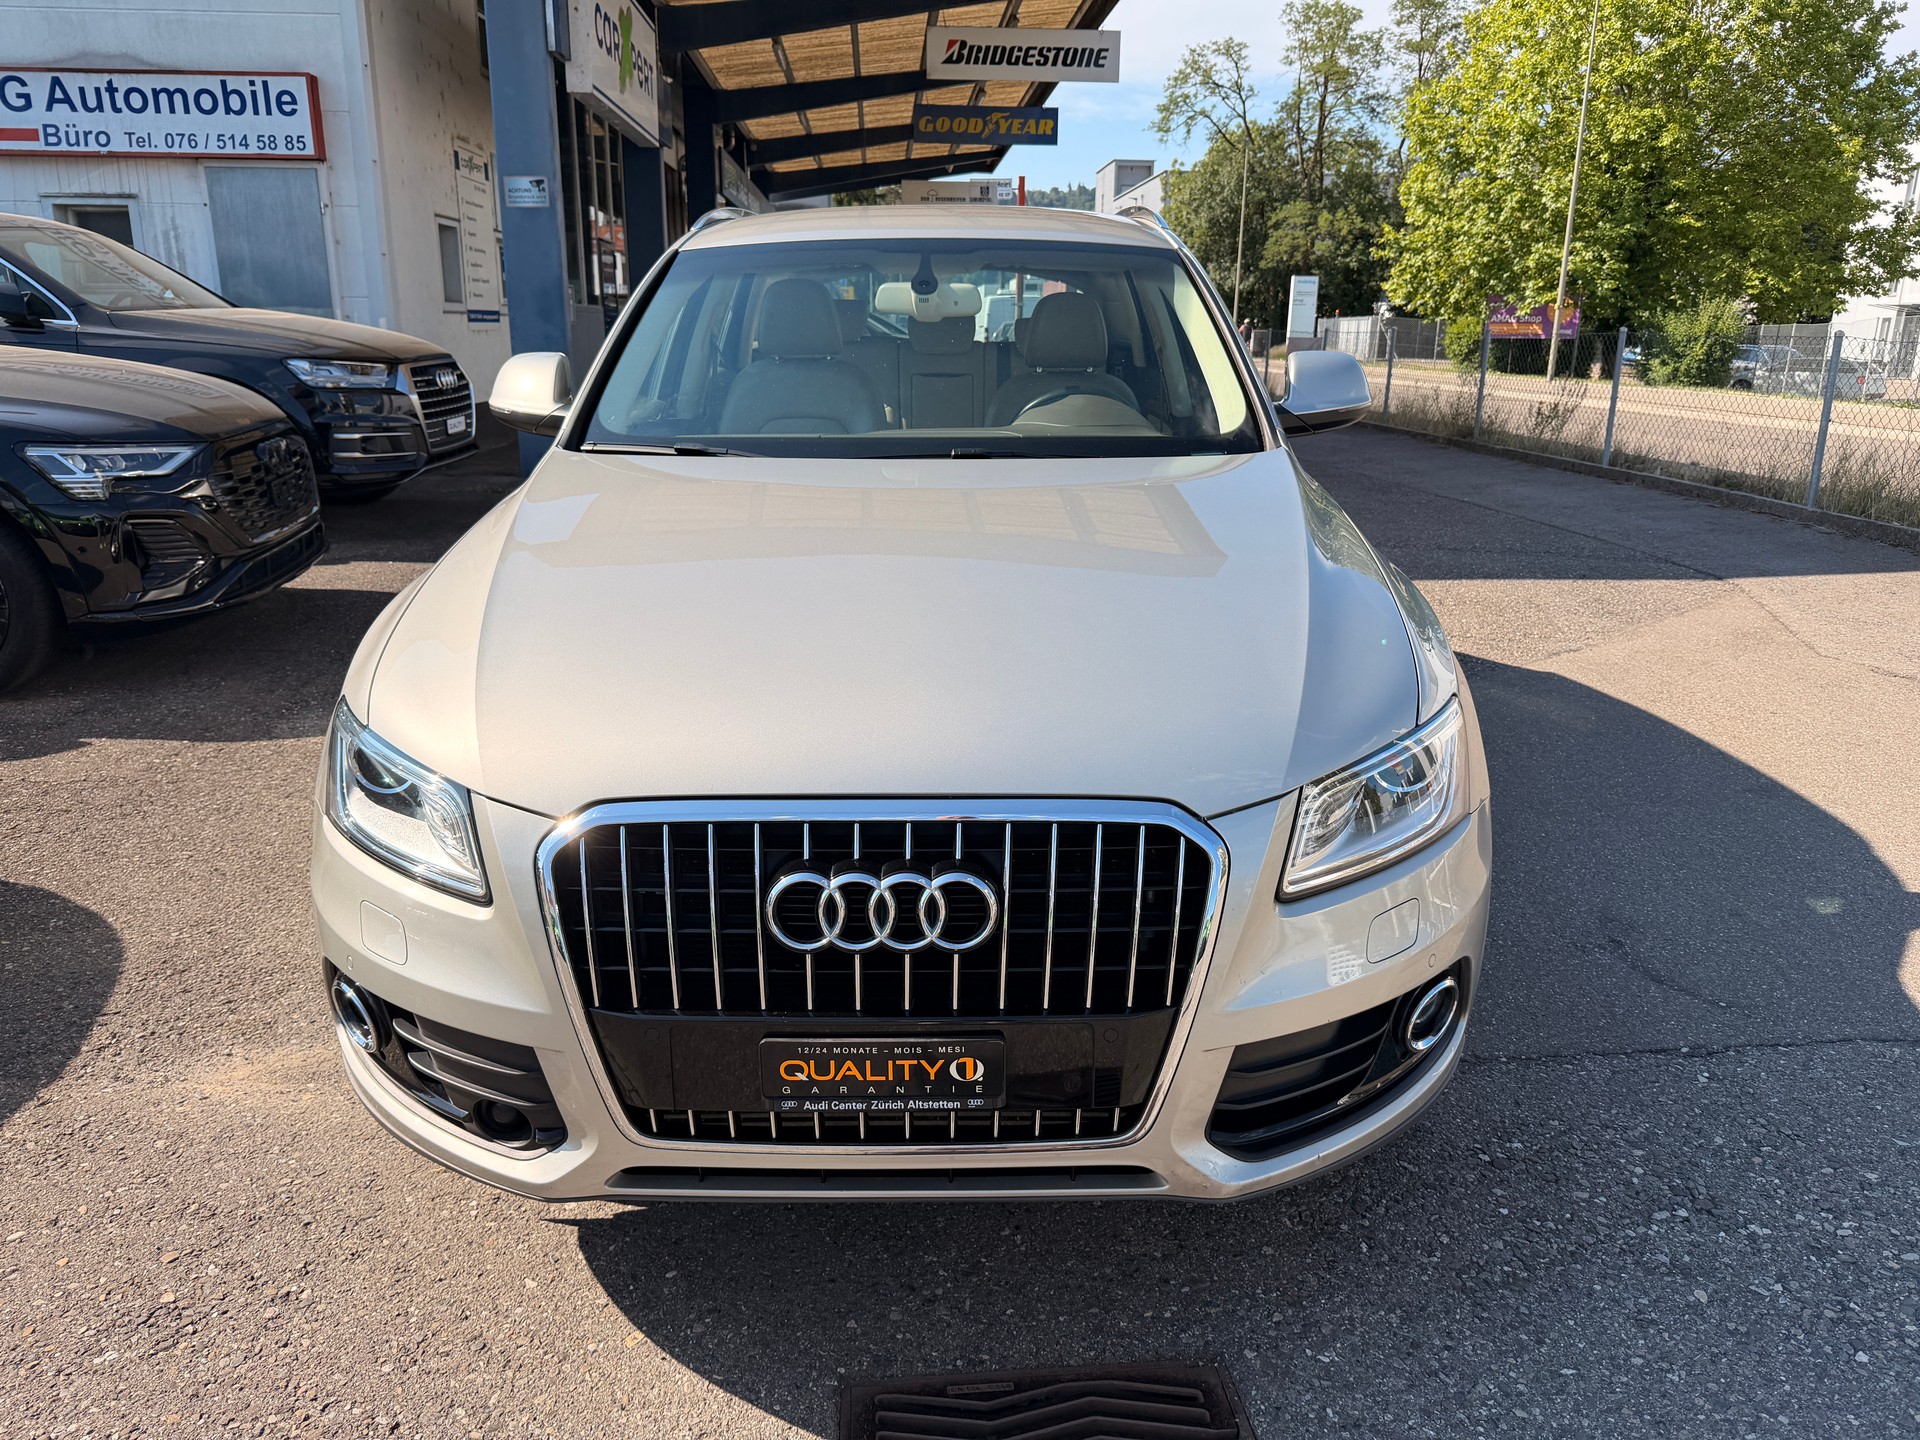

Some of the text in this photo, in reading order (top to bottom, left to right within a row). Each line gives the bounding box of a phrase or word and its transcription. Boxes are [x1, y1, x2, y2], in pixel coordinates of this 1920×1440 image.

[941, 39, 1110, 68] BRIDGESTONE
[45, 76, 298, 117] Automobile
[41, 123, 111, 148] Büro
[124, 131, 158, 149] Tel.
[164, 132, 198, 149] 076
[216, 133, 250, 150] 514
[256, 134, 278, 151] 58
[284, 134, 307, 151] 85
[1490, 314, 1542, 324] AMAG Shop
[938, 1046, 966, 1054] MESI
[779, 1059, 945, 1081] QUALITY
[782, 1085, 983, 1094] GARANTIE
[803, 1100, 829, 1110] Audi
[831, 1100, 867, 1110] Center
[871, 1099, 905, 1110] Zürich
[907, 1099, 961, 1110] Altstetten
